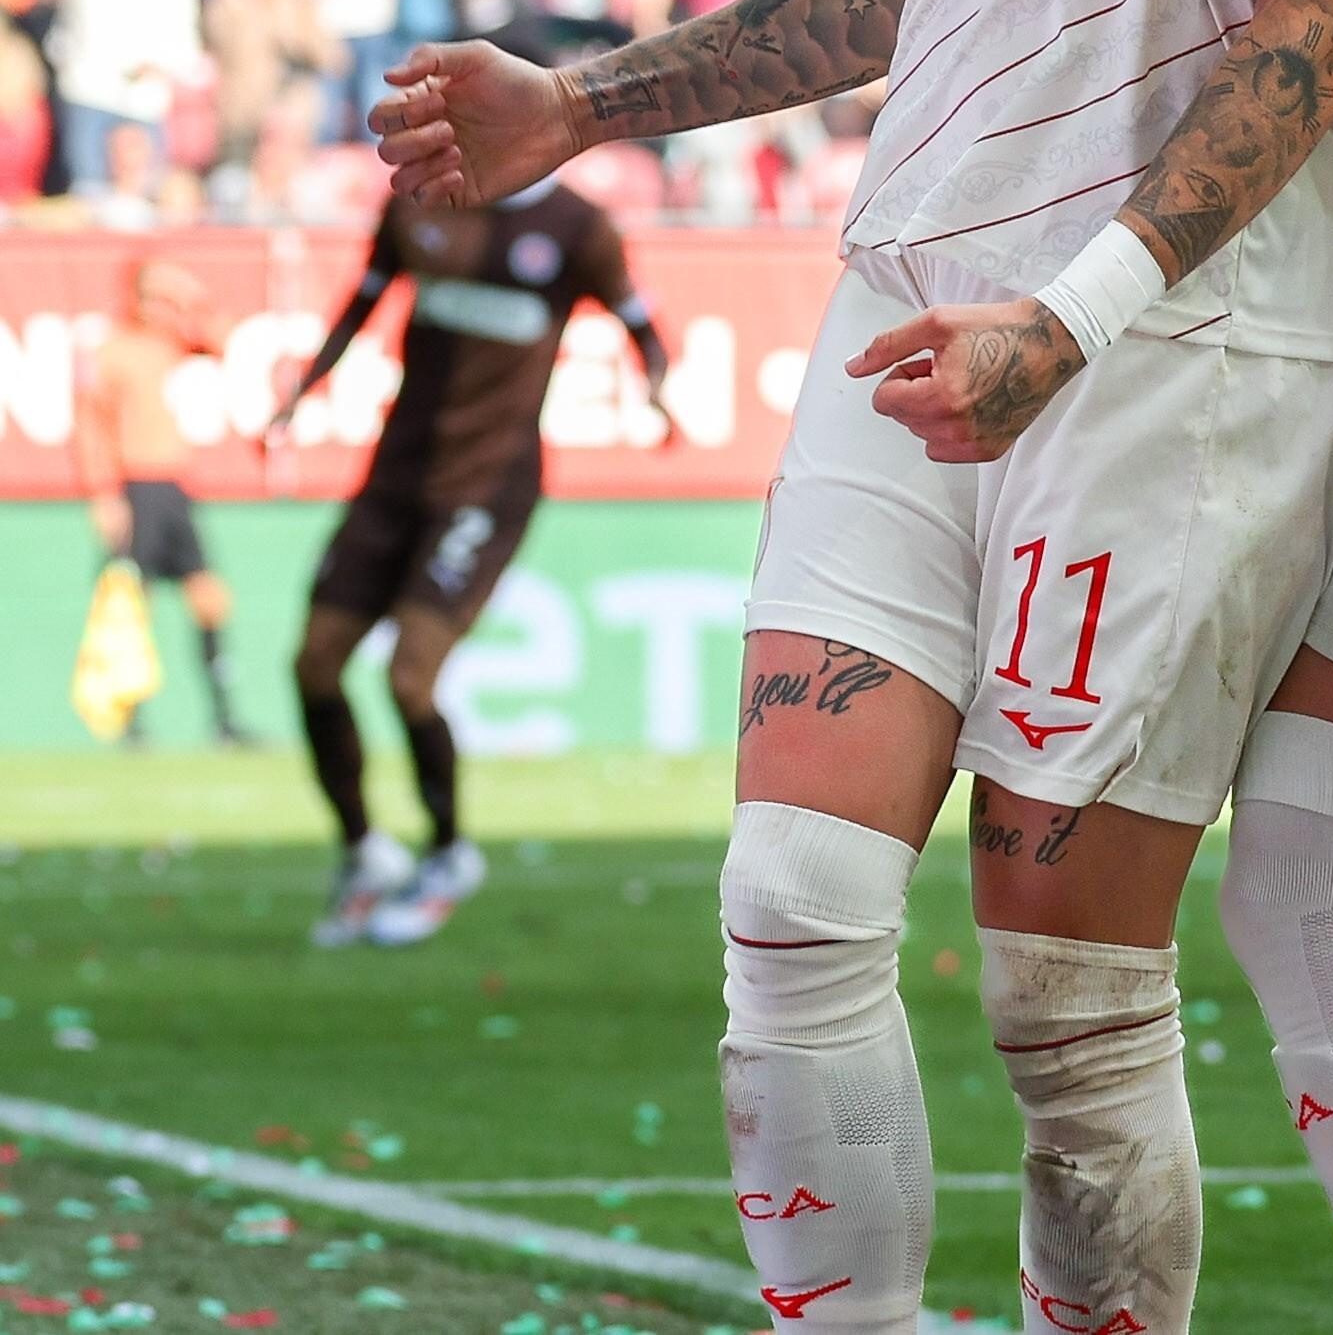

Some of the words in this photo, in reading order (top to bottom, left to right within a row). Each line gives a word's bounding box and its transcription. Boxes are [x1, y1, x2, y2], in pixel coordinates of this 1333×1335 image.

[994, 535, 1112, 705] 11
[741, 657, 892, 737] you'll
[1035, 807, 1080, 866] it
[734, 1186, 837, 1220] CA
